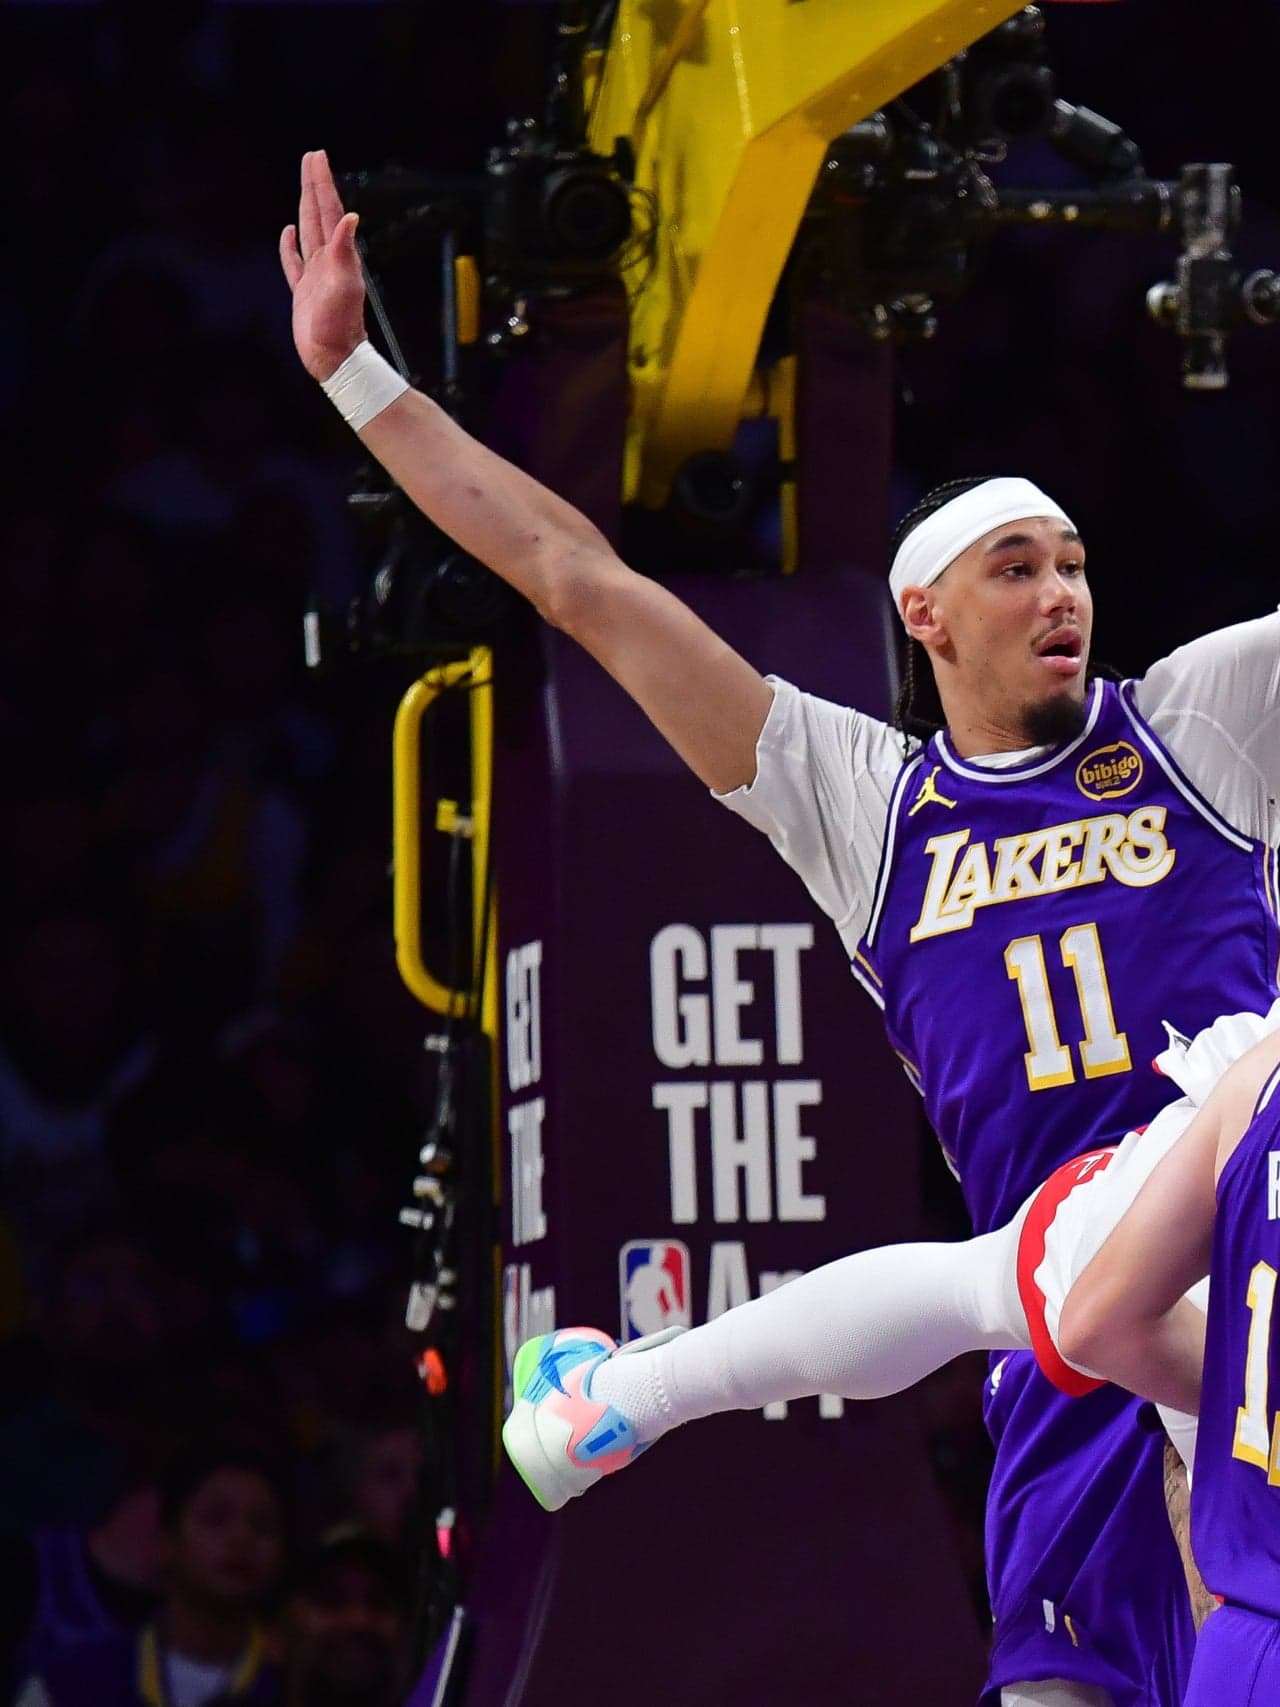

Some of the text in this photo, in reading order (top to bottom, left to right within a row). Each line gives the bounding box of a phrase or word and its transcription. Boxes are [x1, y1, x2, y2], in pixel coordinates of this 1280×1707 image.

[1082, 755, 1138, 784] bibigo
[909, 805, 1176, 943] LAKERS
[650, 923, 815, 1069] GET
[1004, 922, 1132, 1092] 11
[652, 1080, 826, 1224] THE
